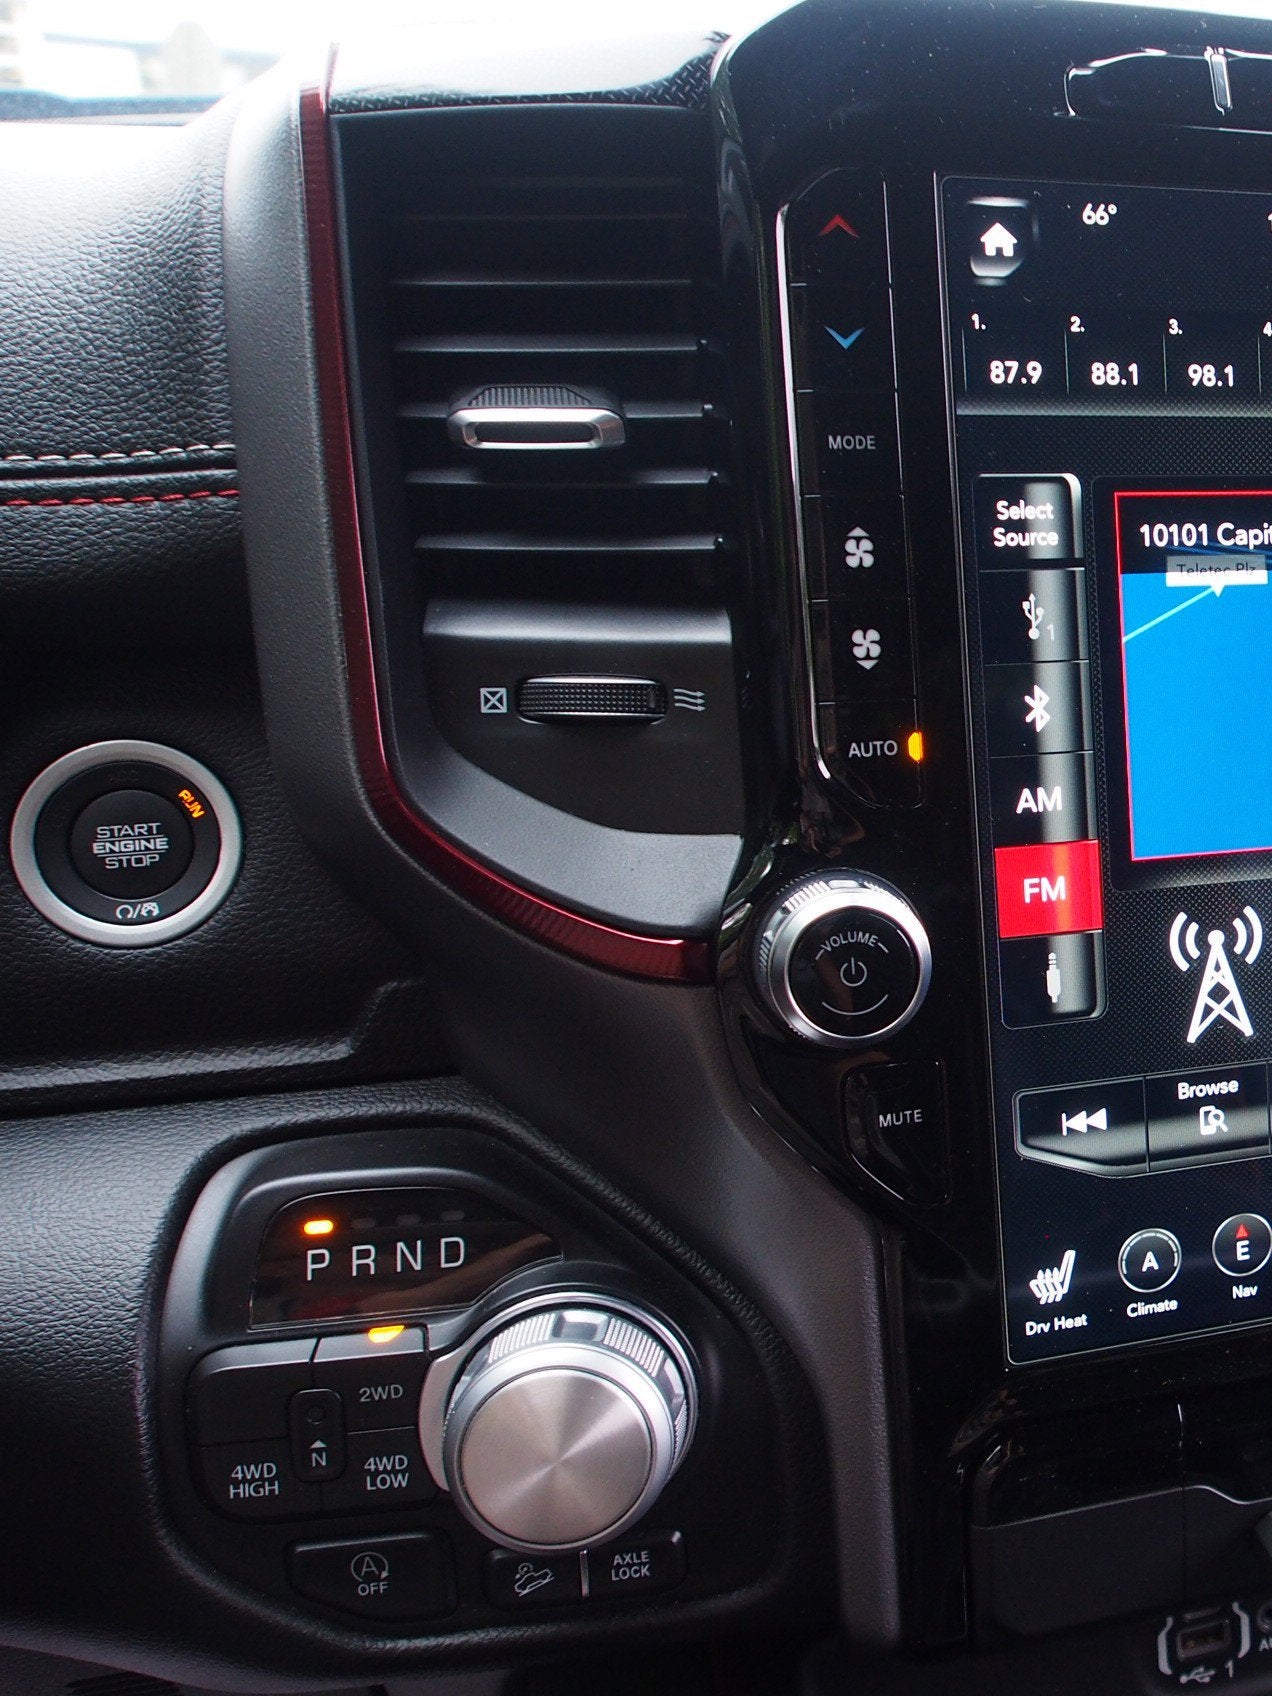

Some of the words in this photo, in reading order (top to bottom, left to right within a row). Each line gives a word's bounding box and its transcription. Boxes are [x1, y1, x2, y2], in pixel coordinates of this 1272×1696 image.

[989, 360, 1043, 386] 87.9
[1090, 361, 1139, 387] 88.1
[1187, 363, 1235, 388] 98.1
[828, 435, 876, 450] MODE
[996, 499, 1054, 520] Select
[993, 526, 1059, 547] Source
[1139, 522, 1209, 547] 10101
[848, 739, 898, 758] AUTO
[178, 789, 205, 818] RUN
[1016, 786, 1062, 813] AM
[97, 822, 161, 839] START
[92, 837, 169, 855] ENGINE
[105, 854, 159, 869] STOP
[1023, 876, 1066, 903] FM
[820, 931, 878, 953] VOLUME
[1178, 1079, 1239, 1099] Browse
[879, 1109, 923, 1128] MUTE
[307, 1249, 330, 1281] P
[352, 1244, 375, 1277] R
[396, 1240, 421, 1273] N
[440, 1237, 465, 1268] D
[1232, 1284, 1258, 1300] Nav
[1126, 1298, 1178, 1318] Climate
[1025, 1319, 1051, 1336] Drv
[1054, 1314, 1088, 1332] Heat
[359, 1384, 403, 1402] 2WD
[230, 1463, 277, 1480] 4WD
[364, 1455, 408, 1473] 4WD
[229, 1480, 279, 1500] HIGH
[366, 1472, 409, 1492] LOW
[613, 1550, 650, 1566] AXLE
[611, 1565, 651, 1581] LOCK
[357, 1581, 389, 1597] OFF
[1224, 1660, 1234, 1678] 1
